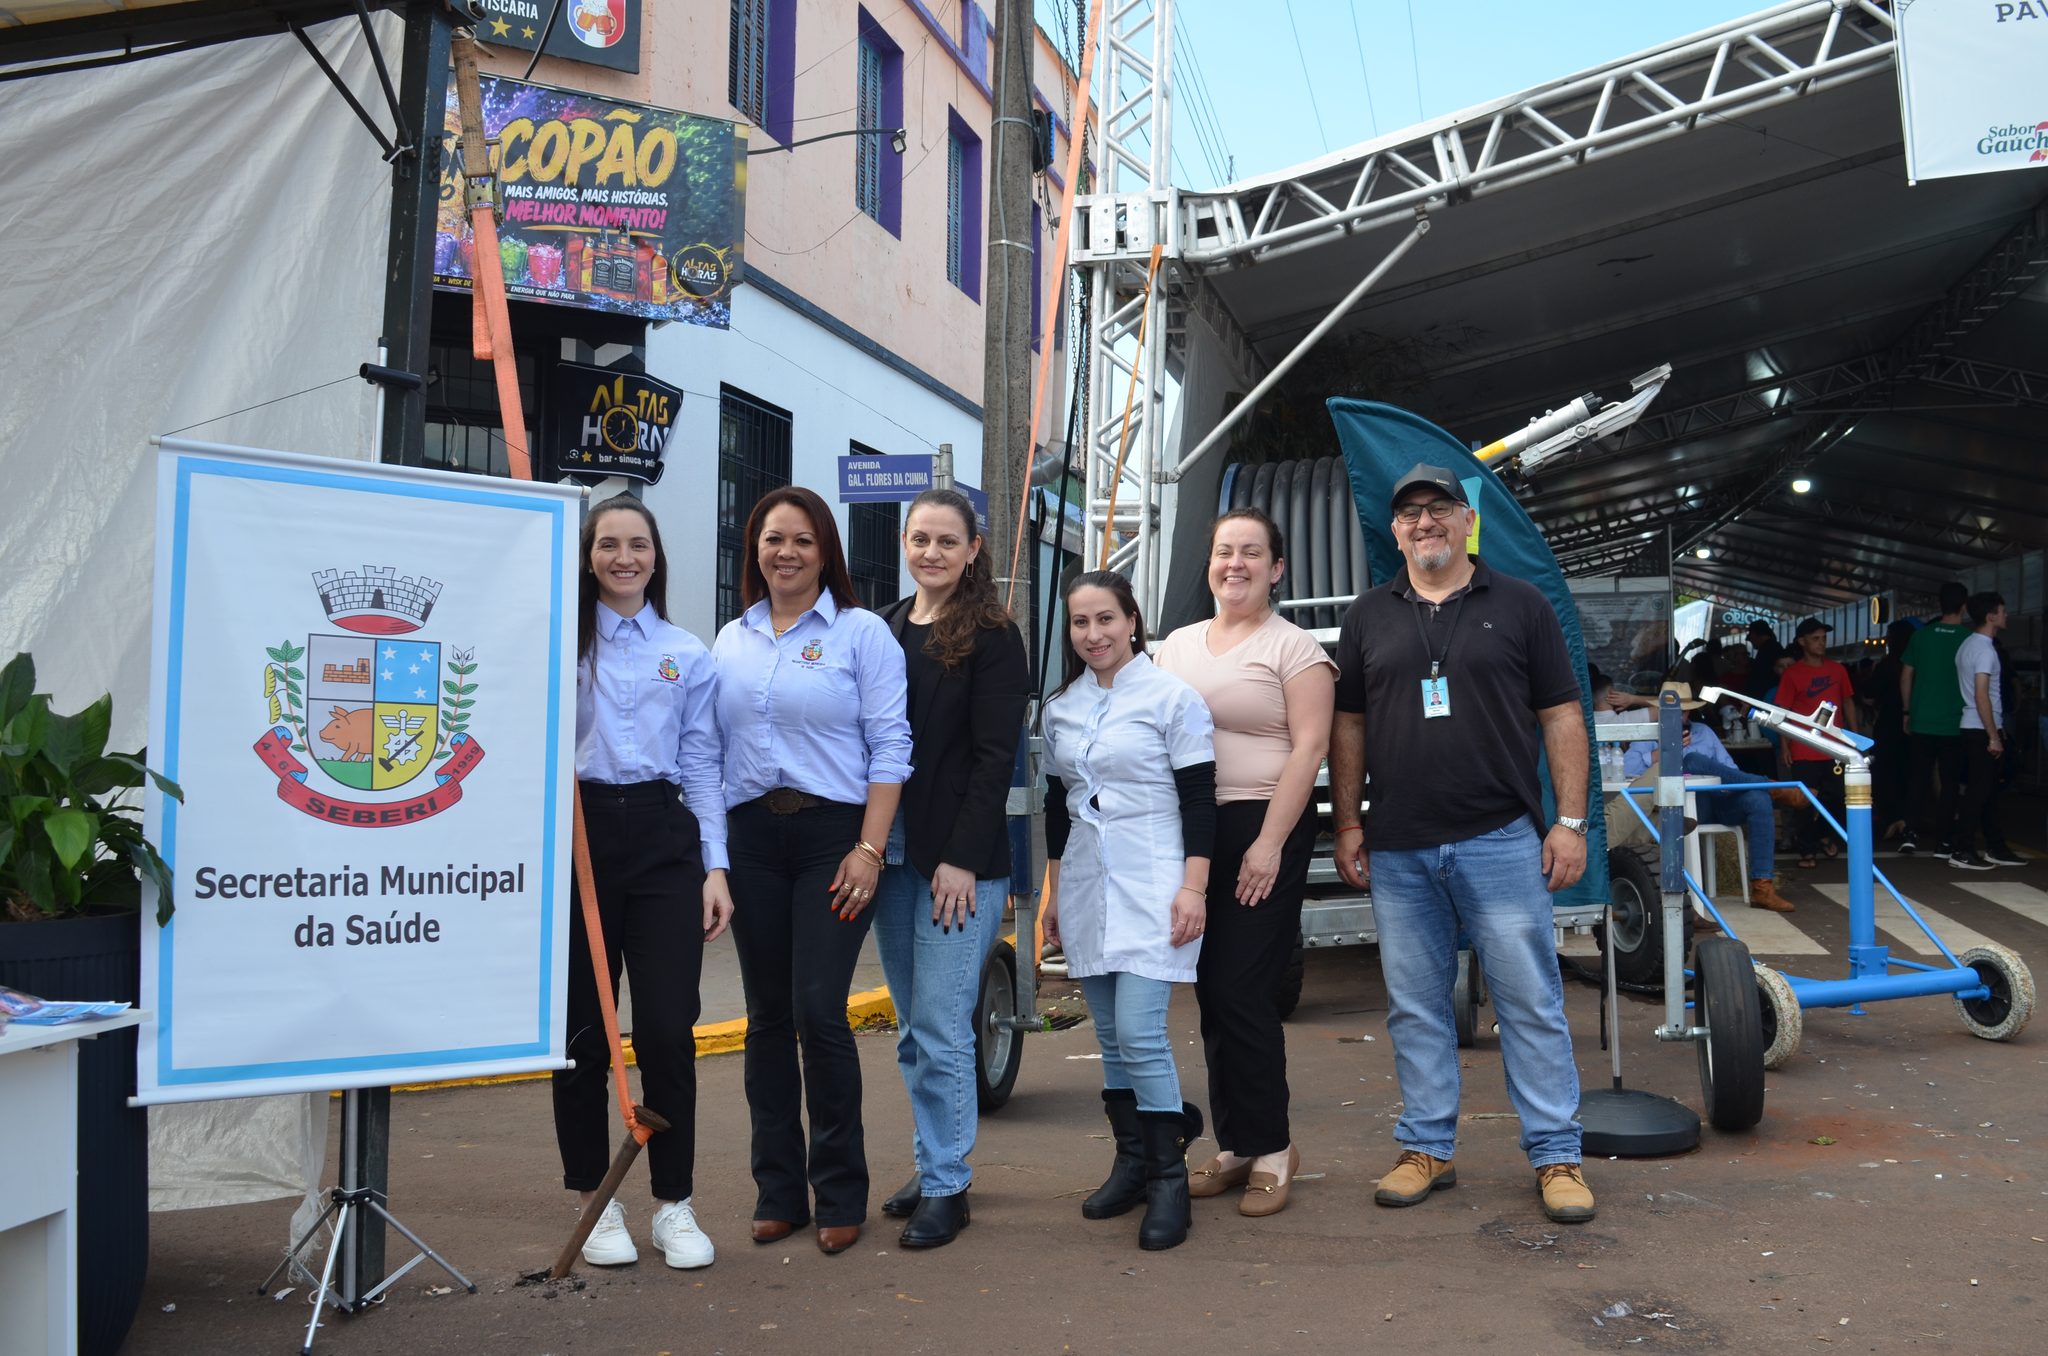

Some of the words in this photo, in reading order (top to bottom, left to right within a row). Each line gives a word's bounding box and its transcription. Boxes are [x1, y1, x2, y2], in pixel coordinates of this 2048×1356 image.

[1988, 124, 2036, 138] Sabor
[491, 108, 678, 188] COPÃO
[505, 185, 533, 199] MAIS
[535, 186, 579, 203] AMIGOS,
[581, 189, 609, 203] MAIS
[611, 189, 669, 207] HISTÓRIAS,
[505, 199, 577, 225] MELHOR
[578, 205, 668, 230] MOMENTO!
[681, 267, 718, 280] HORAS
[684, 258, 717, 271] ALTAS
[510, 285, 535, 295] ENERGIA
[535, 289, 547, 297] QUE
[548, 290, 560, 299] NÃO
[590, 375, 669, 425] ALTAS
[598, 453, 613, 463] bar
[619, 454, 642, 466] sinuca
[848, 461, 881, 470] AVENIDA
[848, 474, 865, 487] GAL.
[866, 473, 892, 486] FLORES
[893, 473, 903, 485] DA
[904, 472, 929, 485] CUNHA
[452, 746, 480, 775] 1959
[306, 796, 438, 825] SEBERI
[194, 865, 369, 899] Secretaria
[380, 863, 525, 901] Municipal
[294, 915, 335, 948] da
[345, 910, 441, 946] Saúde
